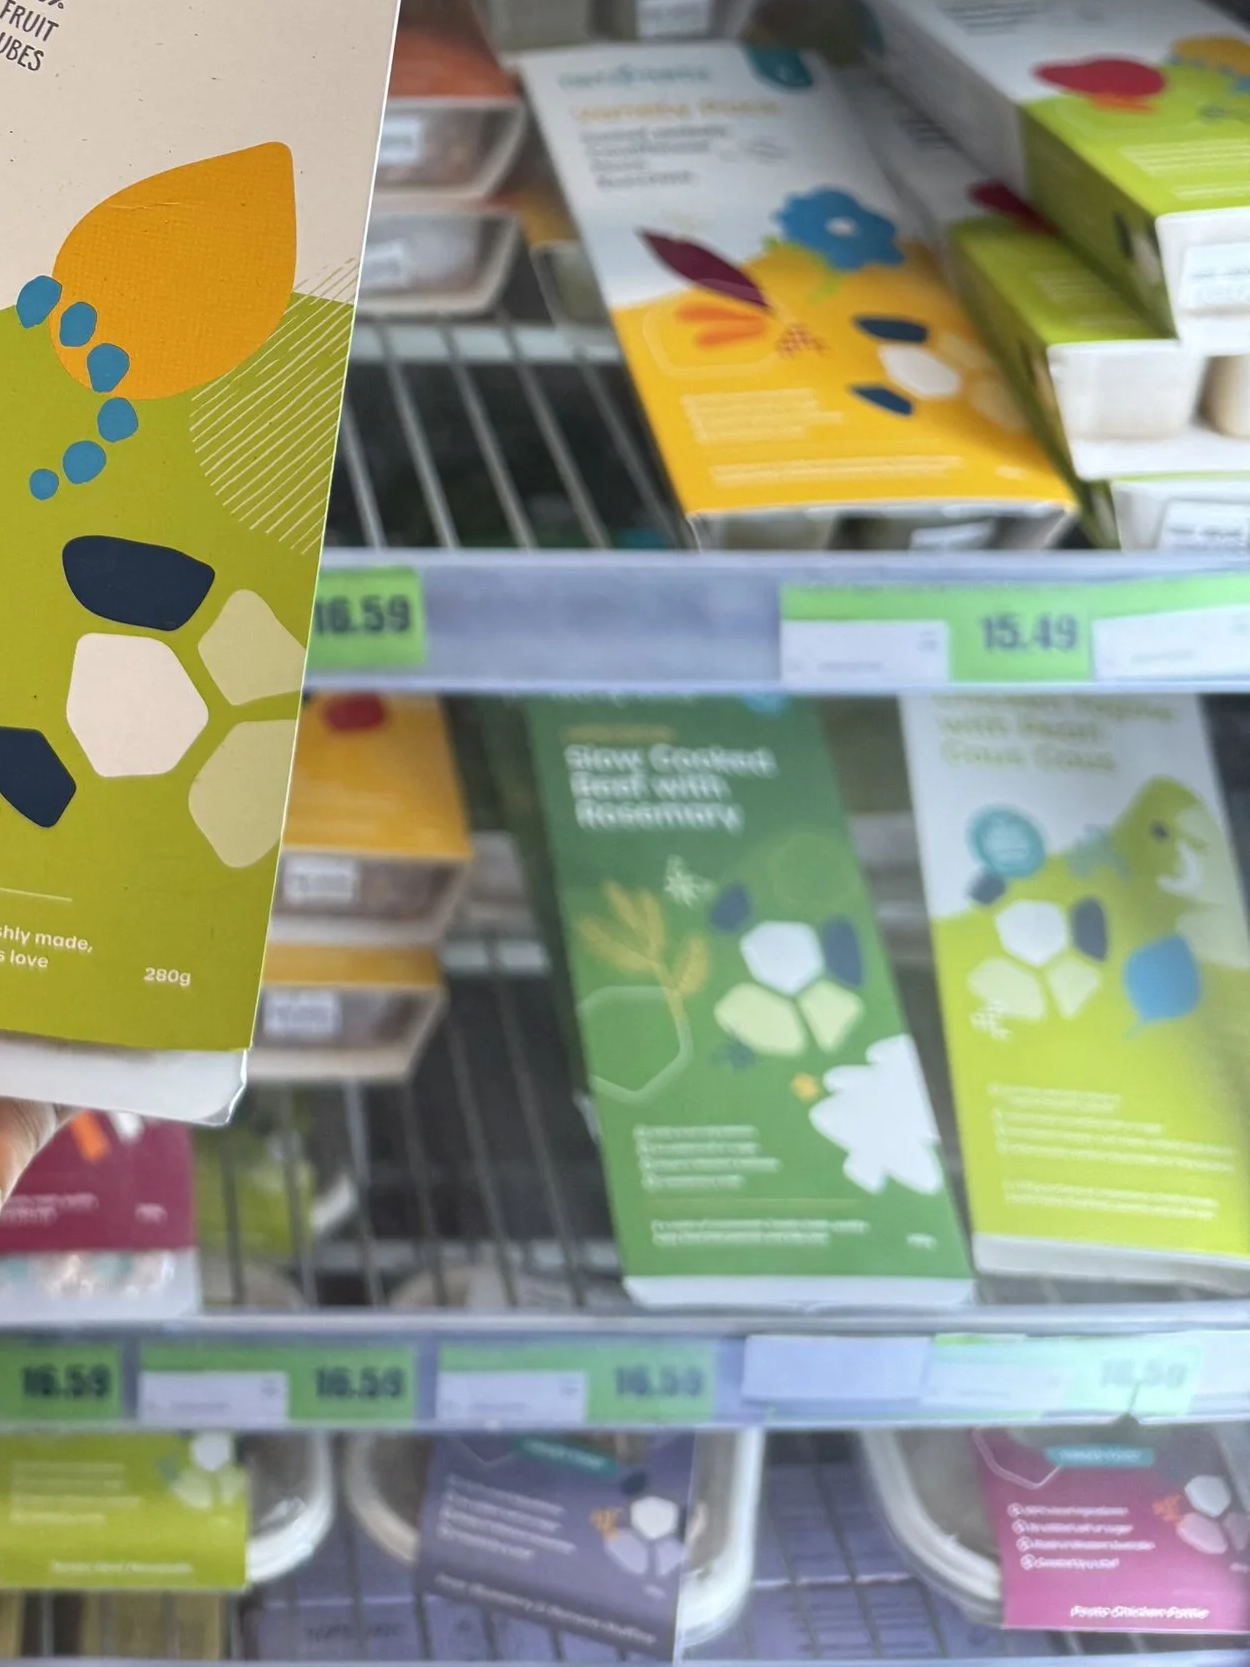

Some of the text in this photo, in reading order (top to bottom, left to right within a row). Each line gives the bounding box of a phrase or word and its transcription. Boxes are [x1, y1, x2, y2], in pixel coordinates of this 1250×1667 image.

[975, 611, 1079, 653] 15.49
[34, 931, 94, 954] made,
[9, 947, 50, 969] love
[144, 966, 192, 987] 280g
